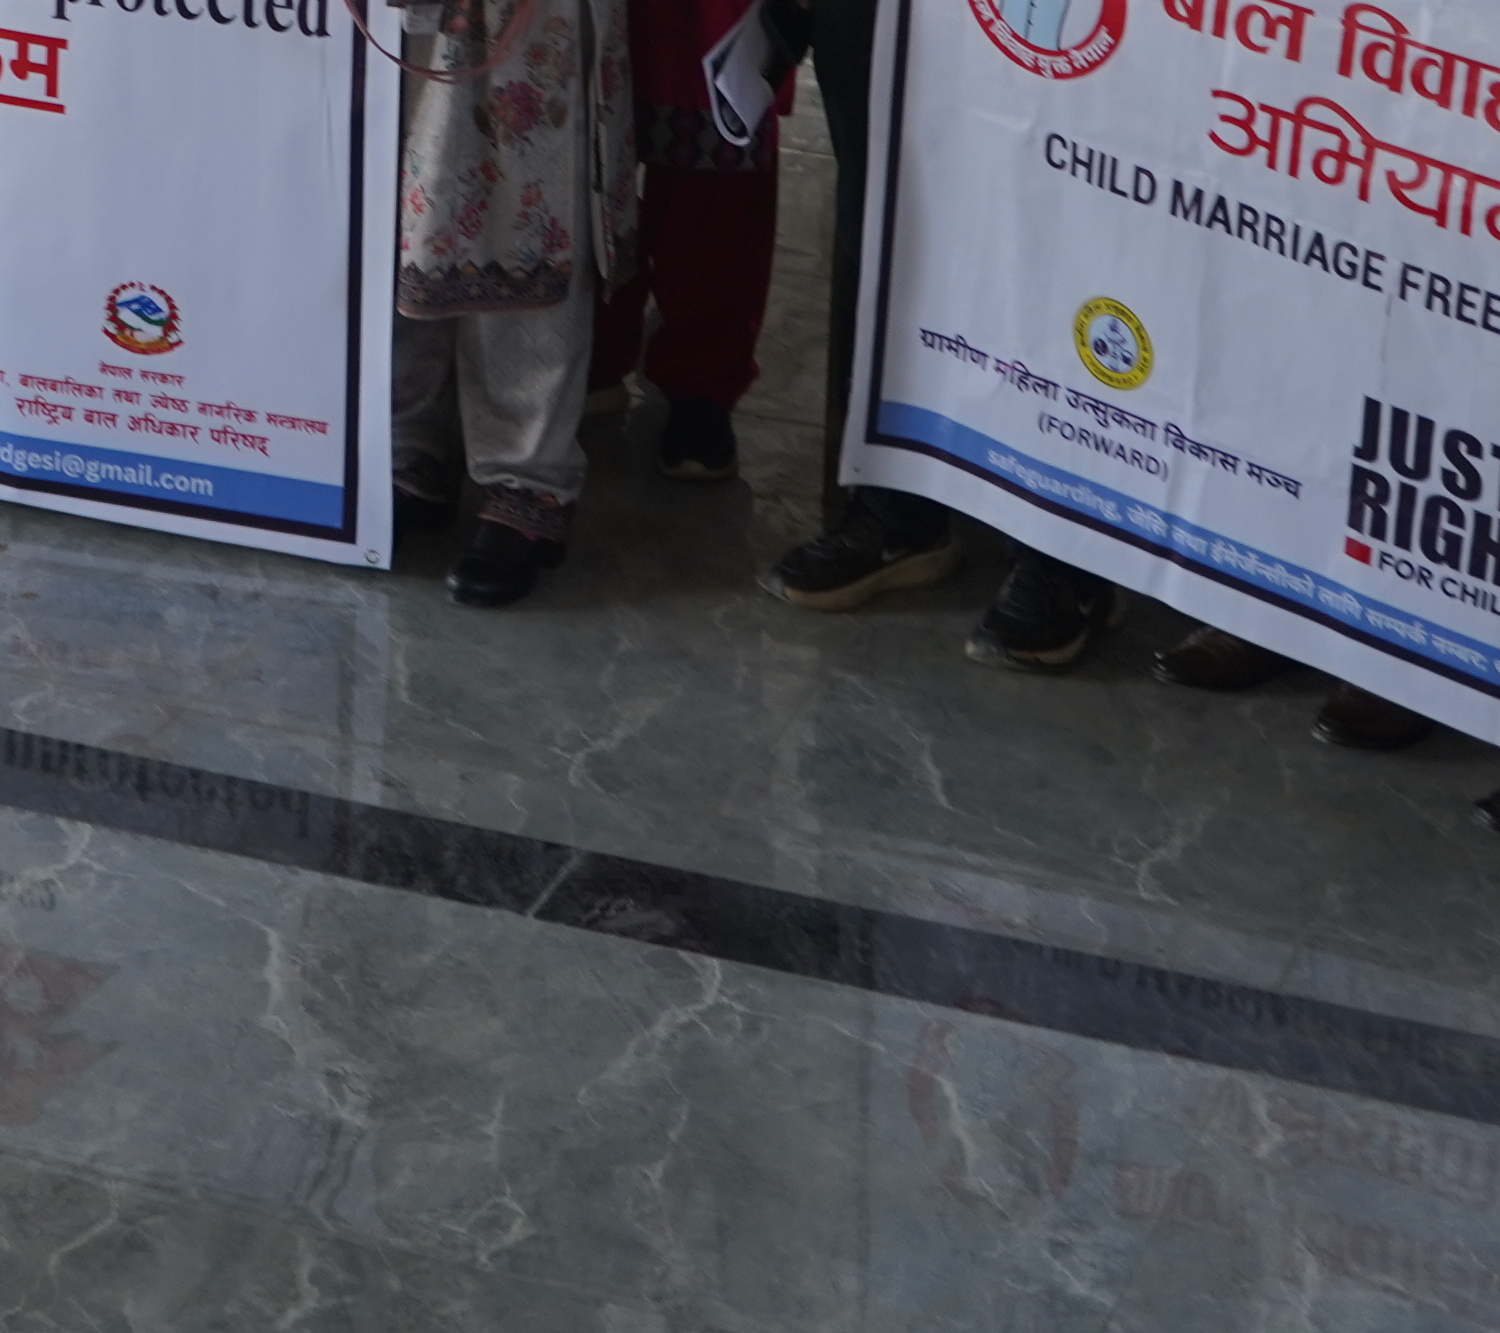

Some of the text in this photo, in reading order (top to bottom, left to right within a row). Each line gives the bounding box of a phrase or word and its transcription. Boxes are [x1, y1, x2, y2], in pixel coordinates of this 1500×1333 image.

[1044, 133, 1157, 206] CHILD
[1171, 180, 1389, 293] MARRIAGE
[83, 408, 119, 430] बाल
[1037, 411, 1169, 482] (FORWARD)
[1377, 551, 1433, 590] FOR
